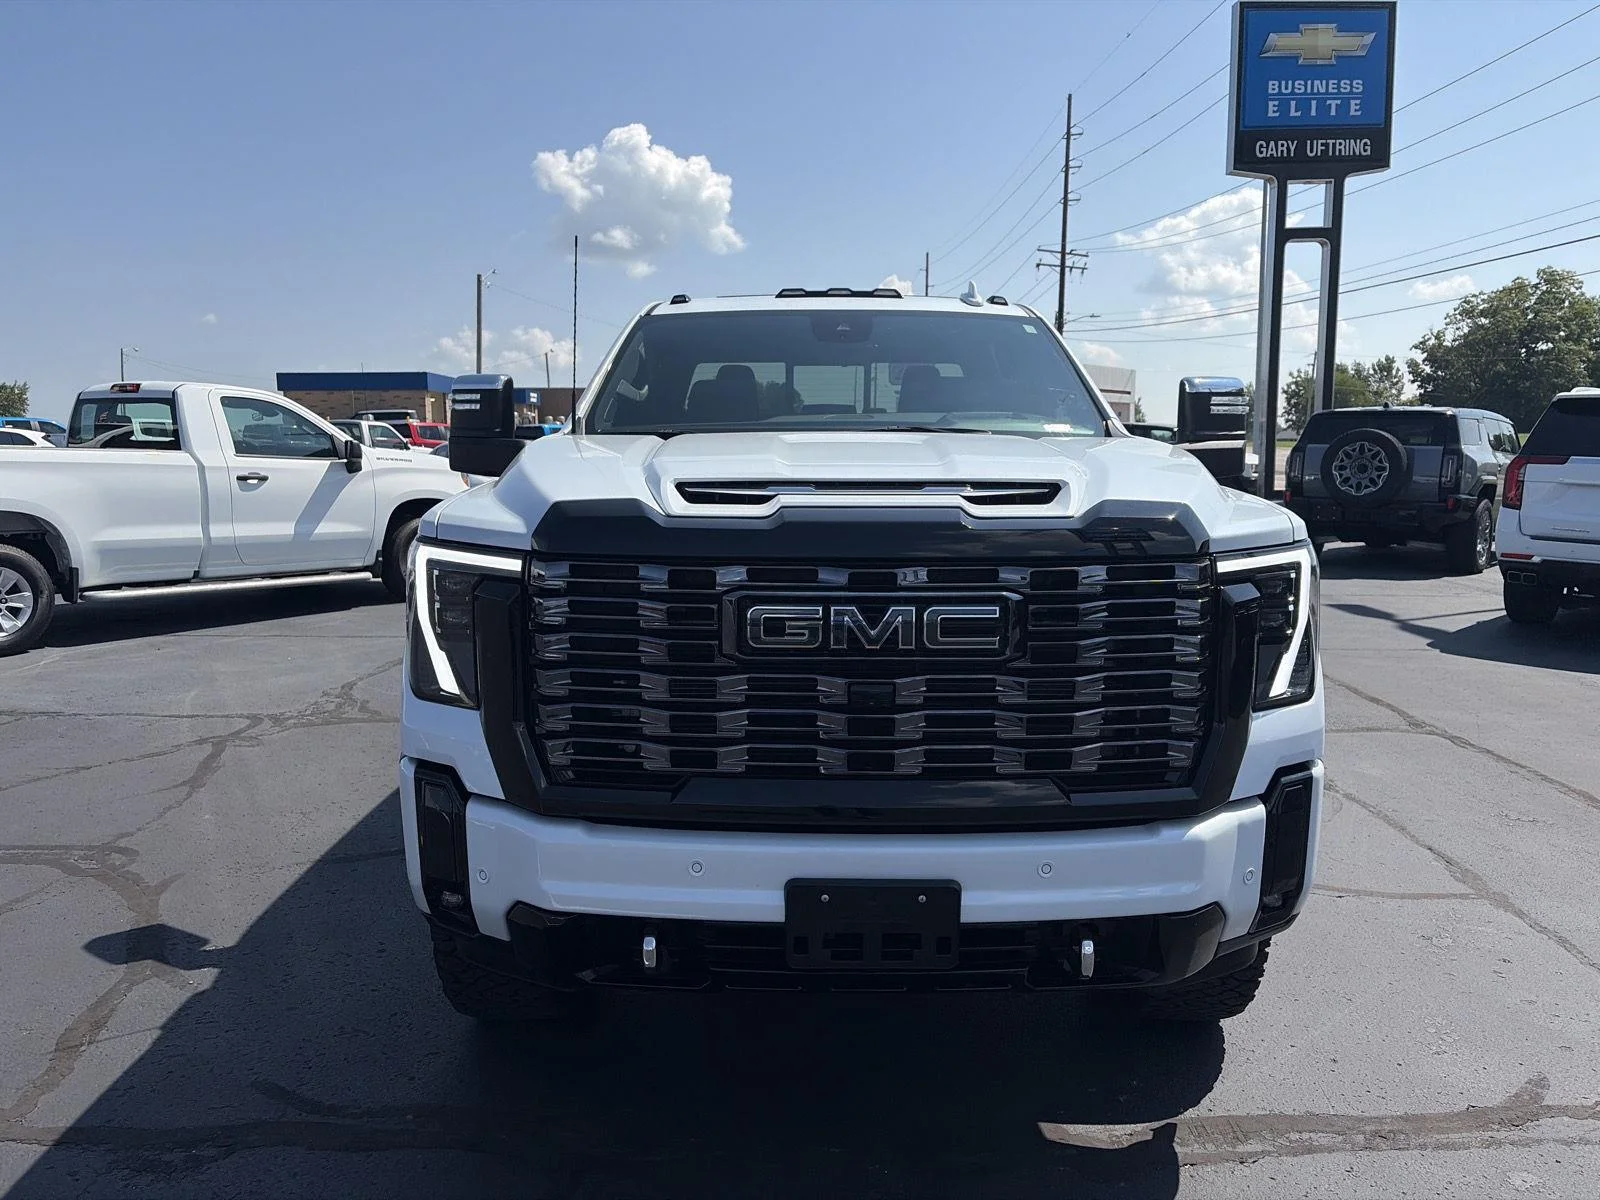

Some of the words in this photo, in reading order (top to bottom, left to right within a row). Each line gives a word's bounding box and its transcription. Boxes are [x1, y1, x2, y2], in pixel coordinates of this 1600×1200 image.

[1268, 80, 1363, 94] BUSINESS
[1267, 100, 1362, 117] ELITE
[1255, 140, 1297, 158] GARY
[1306, 139, 1371, 157] UFTRING
[747, 606, 998, 649] GMC
